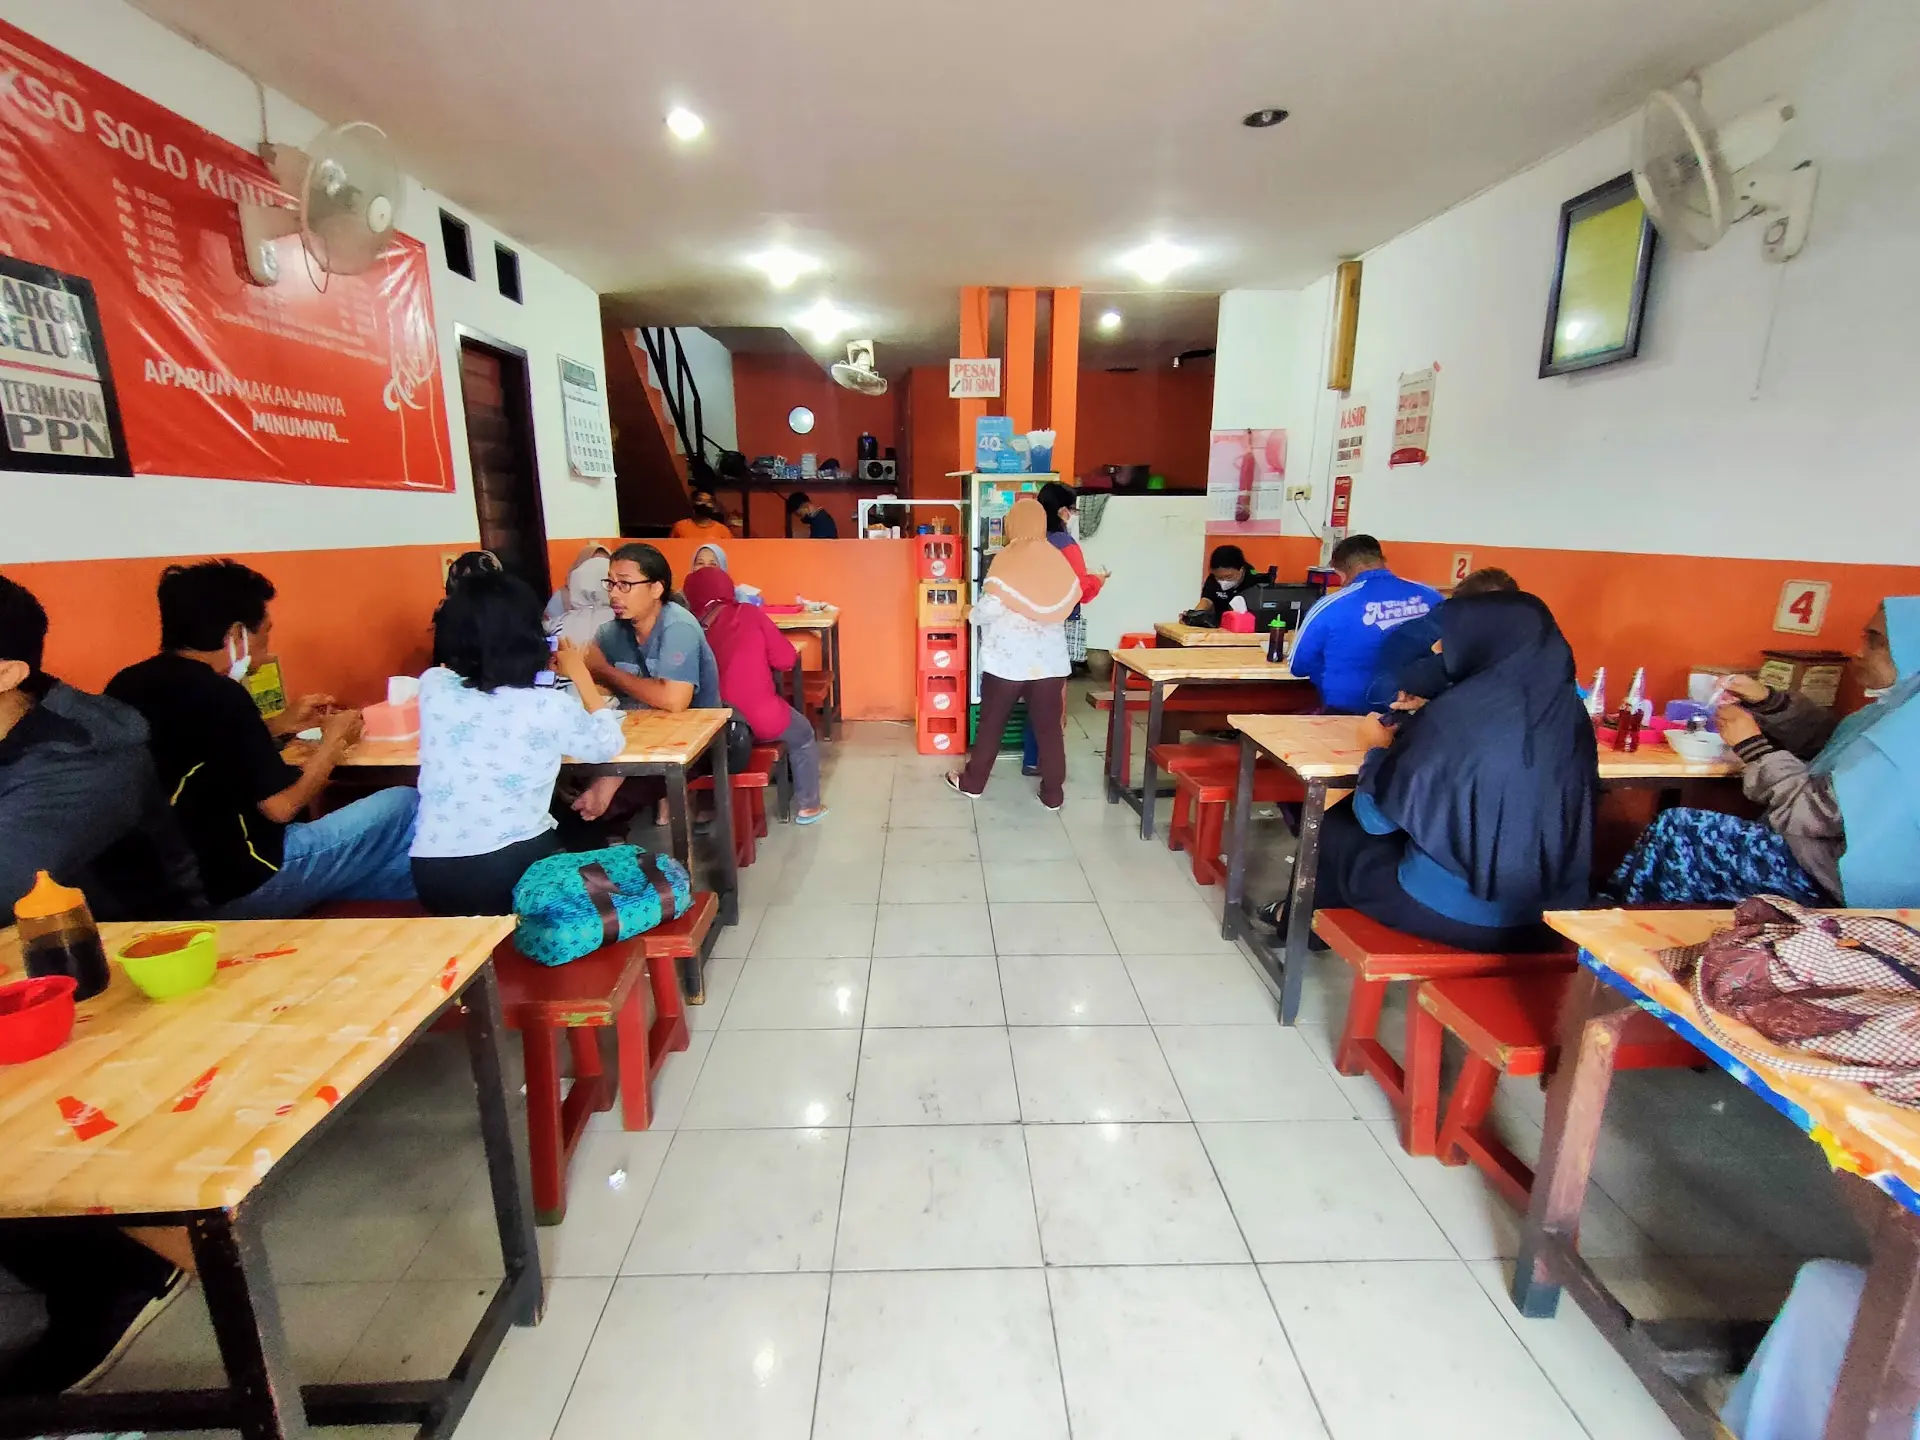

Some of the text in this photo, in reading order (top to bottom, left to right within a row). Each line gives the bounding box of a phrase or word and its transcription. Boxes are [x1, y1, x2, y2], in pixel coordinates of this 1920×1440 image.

[92, 109, 188, 180] SOLO
[954, 363, 996, 378] PESAN
[962, 379, 995, 392] DI SINI
[6, 413, 111, 457] PPN
[1456, 558, 1467, 579] 2
[1789, 591, 1816, 624] 4
